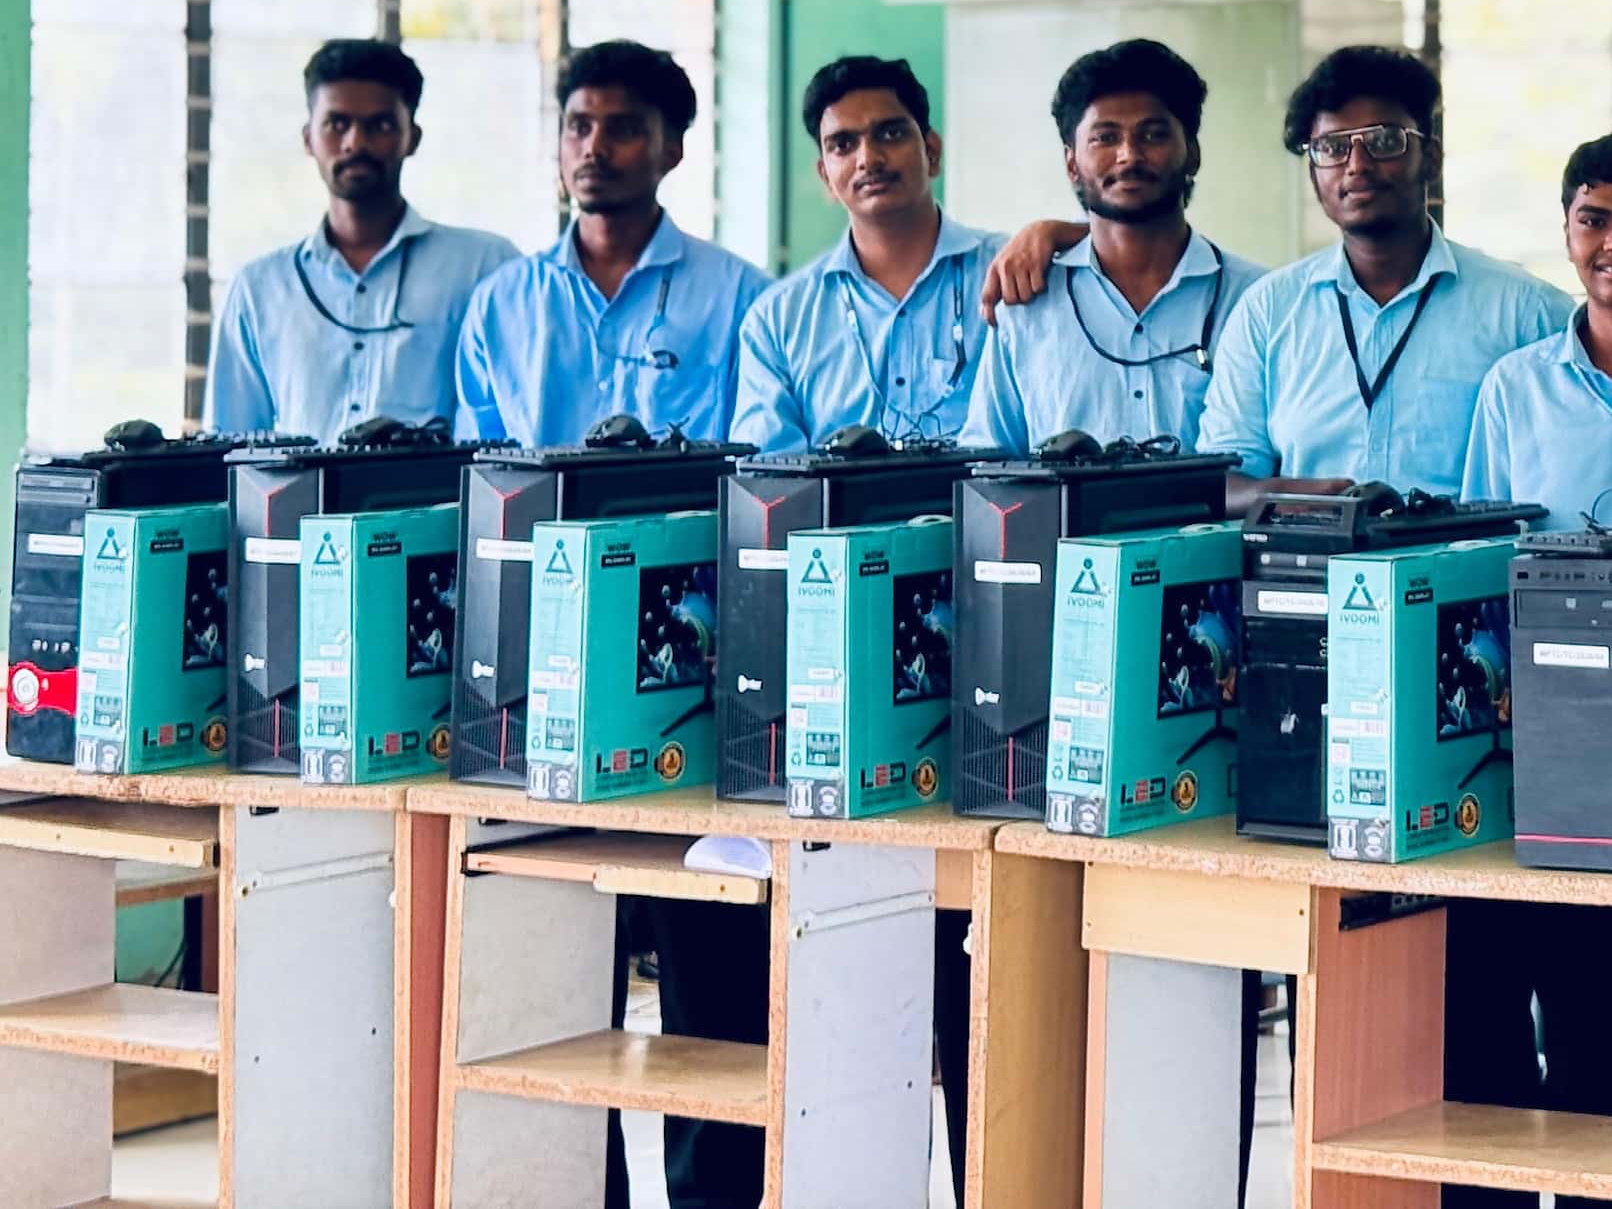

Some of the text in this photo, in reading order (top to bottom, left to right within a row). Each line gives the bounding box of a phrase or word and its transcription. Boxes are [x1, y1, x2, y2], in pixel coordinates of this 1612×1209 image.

[596, 748, 648, 774] LED
[861, 761, 906, 789] LED
[1121, 777, 1165, 805] LED
[1406, 802, 1450, 832] LED
